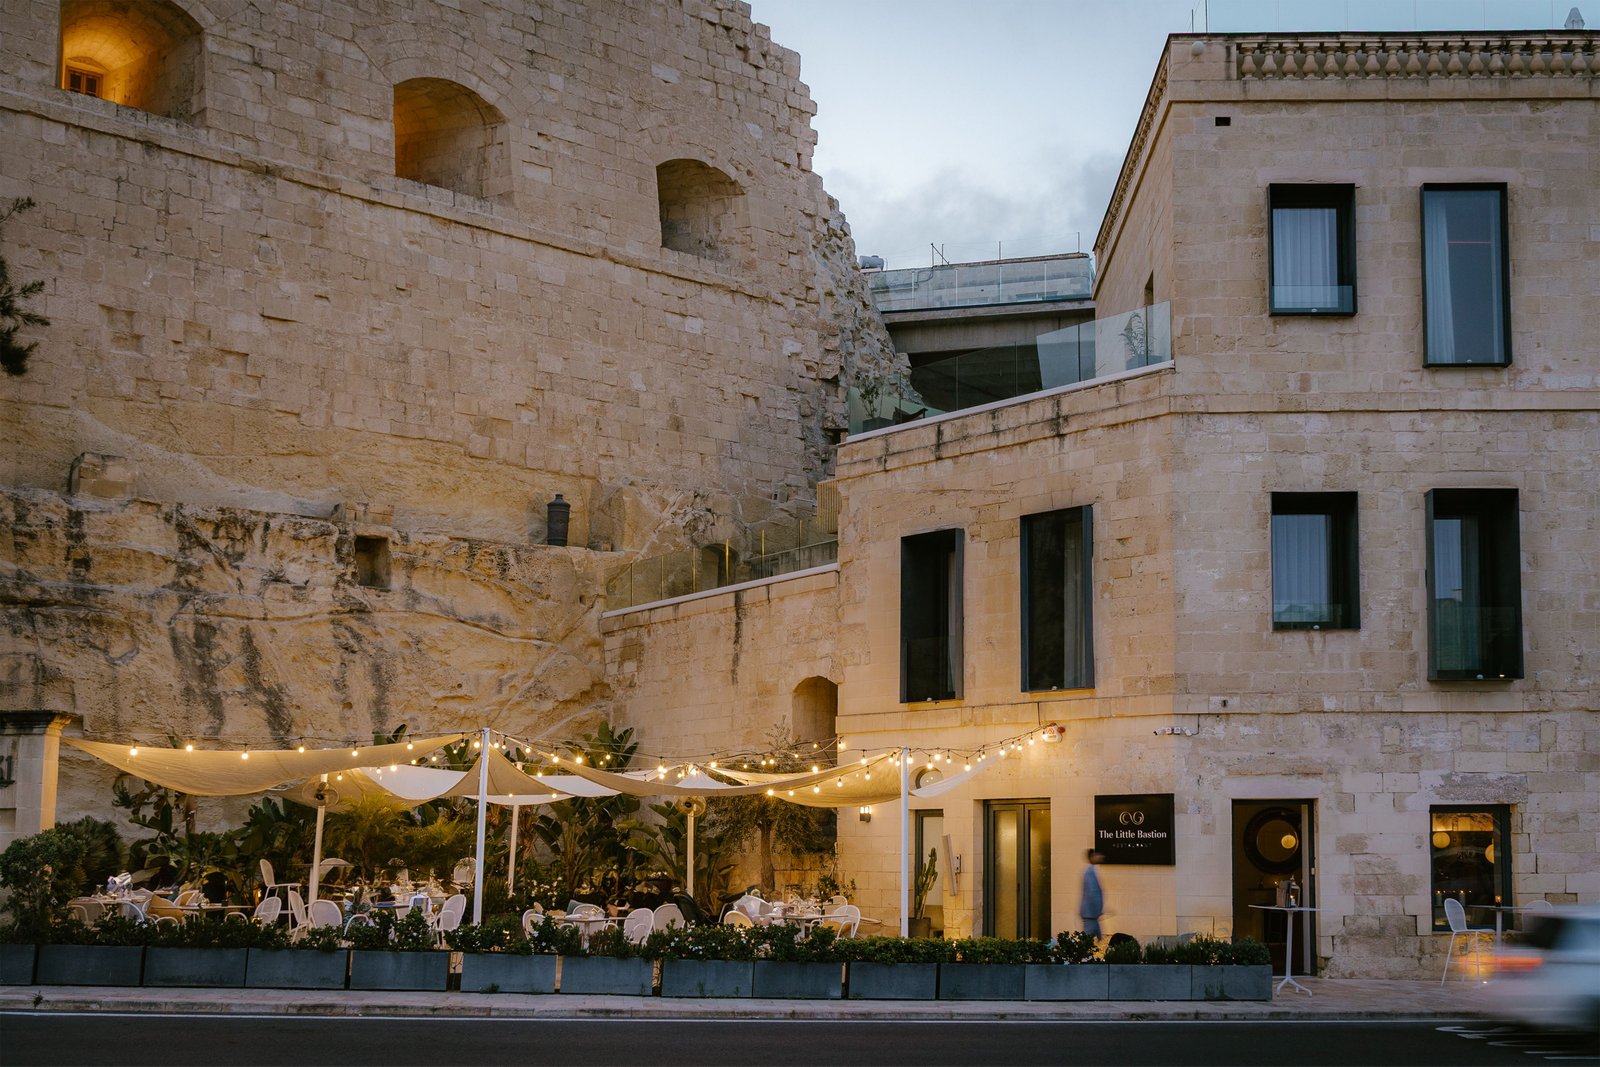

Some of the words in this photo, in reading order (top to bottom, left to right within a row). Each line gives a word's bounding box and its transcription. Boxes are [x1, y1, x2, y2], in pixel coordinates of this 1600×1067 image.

[1099, 830, 1114, 839] The
[1115, 829, 1136, 839] Little
[1137, 829, 1167, 839] Bastion
